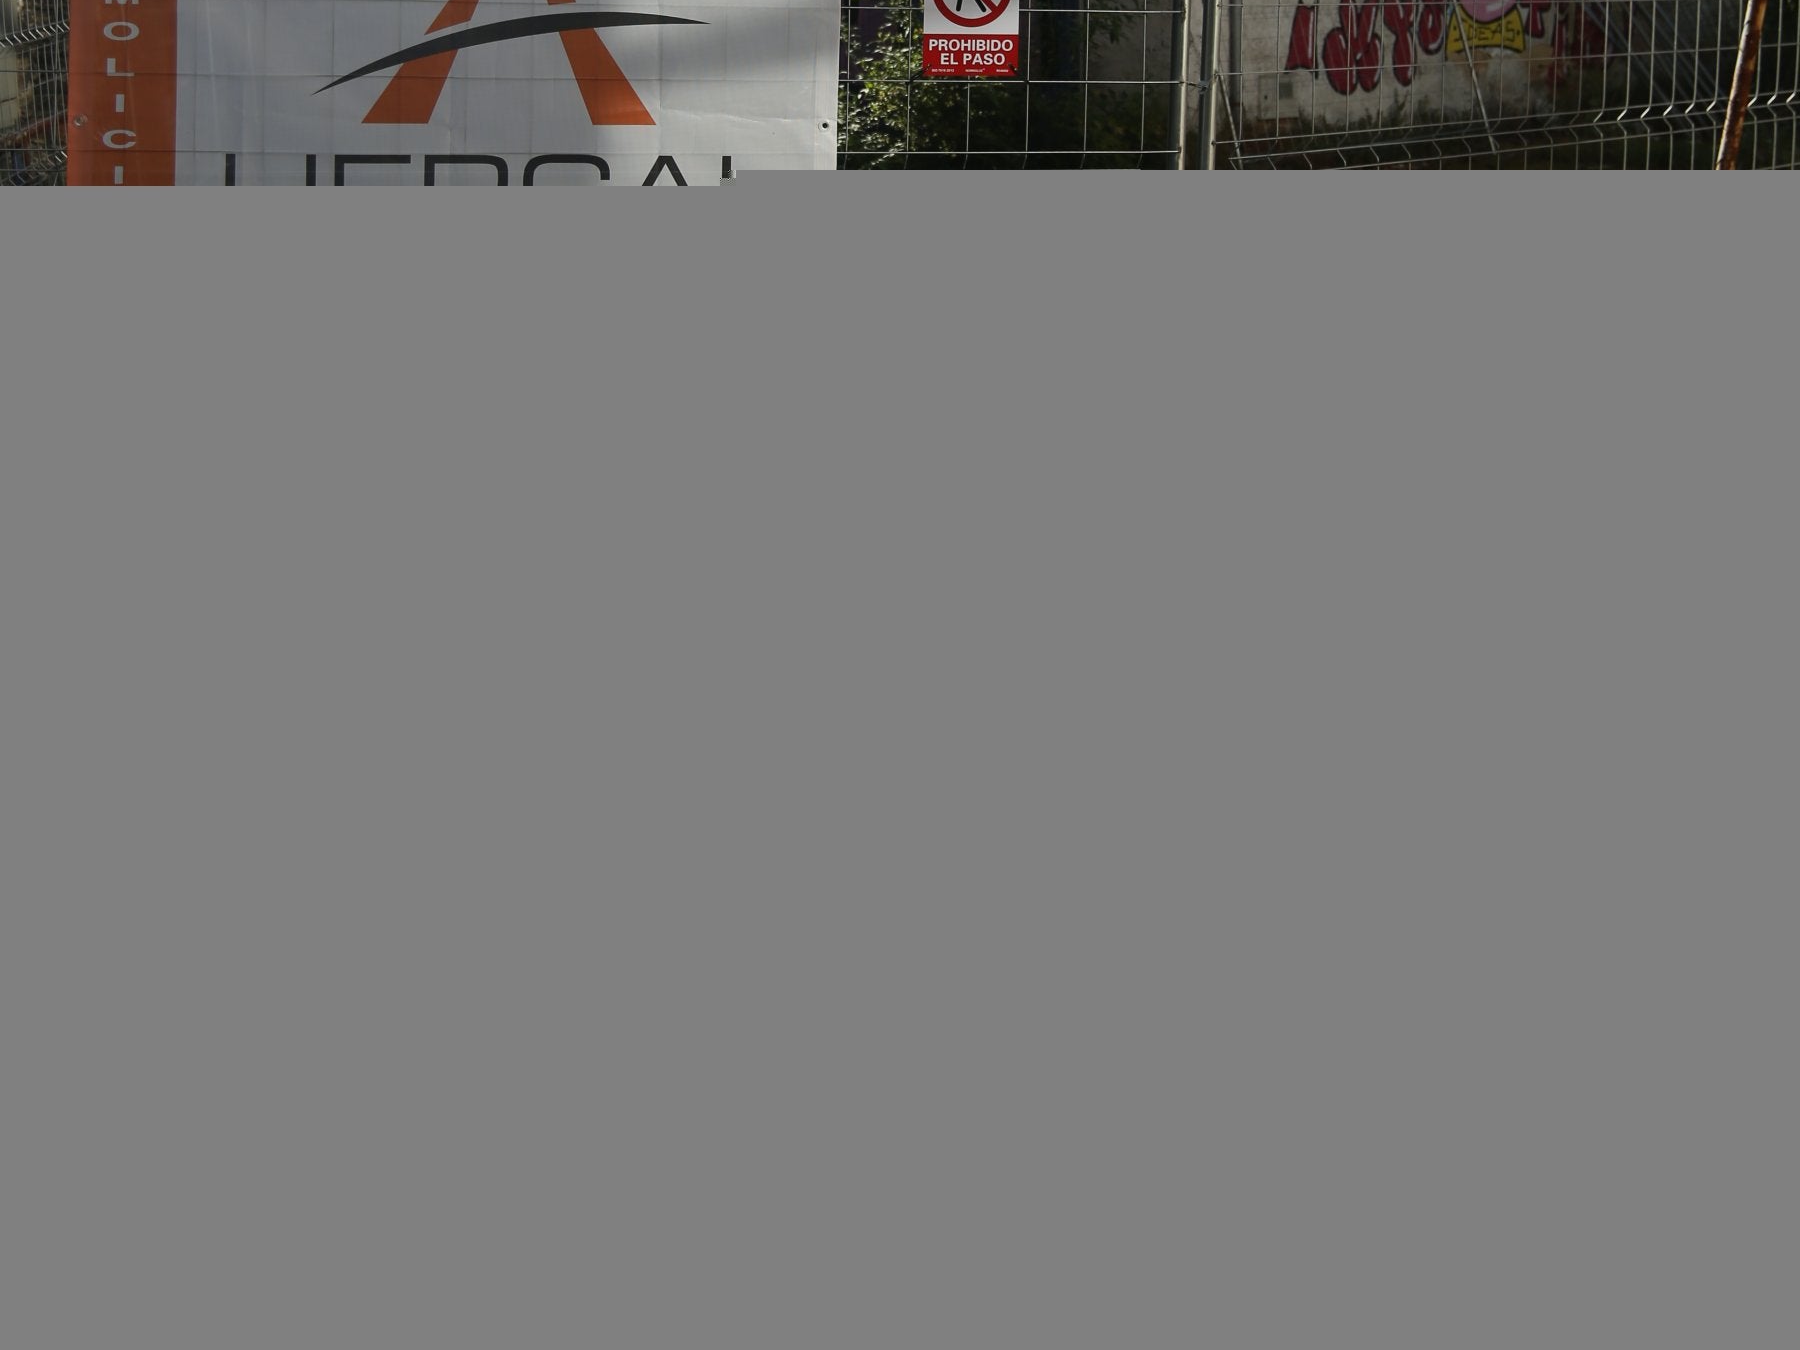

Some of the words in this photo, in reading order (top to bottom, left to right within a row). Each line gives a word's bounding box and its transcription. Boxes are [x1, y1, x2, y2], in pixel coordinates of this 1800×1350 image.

[929, 39, 1013, 51] PROHIBIDO
[940, 53, 958, 65] EL
[963, 53, 1006, 65] PASO
